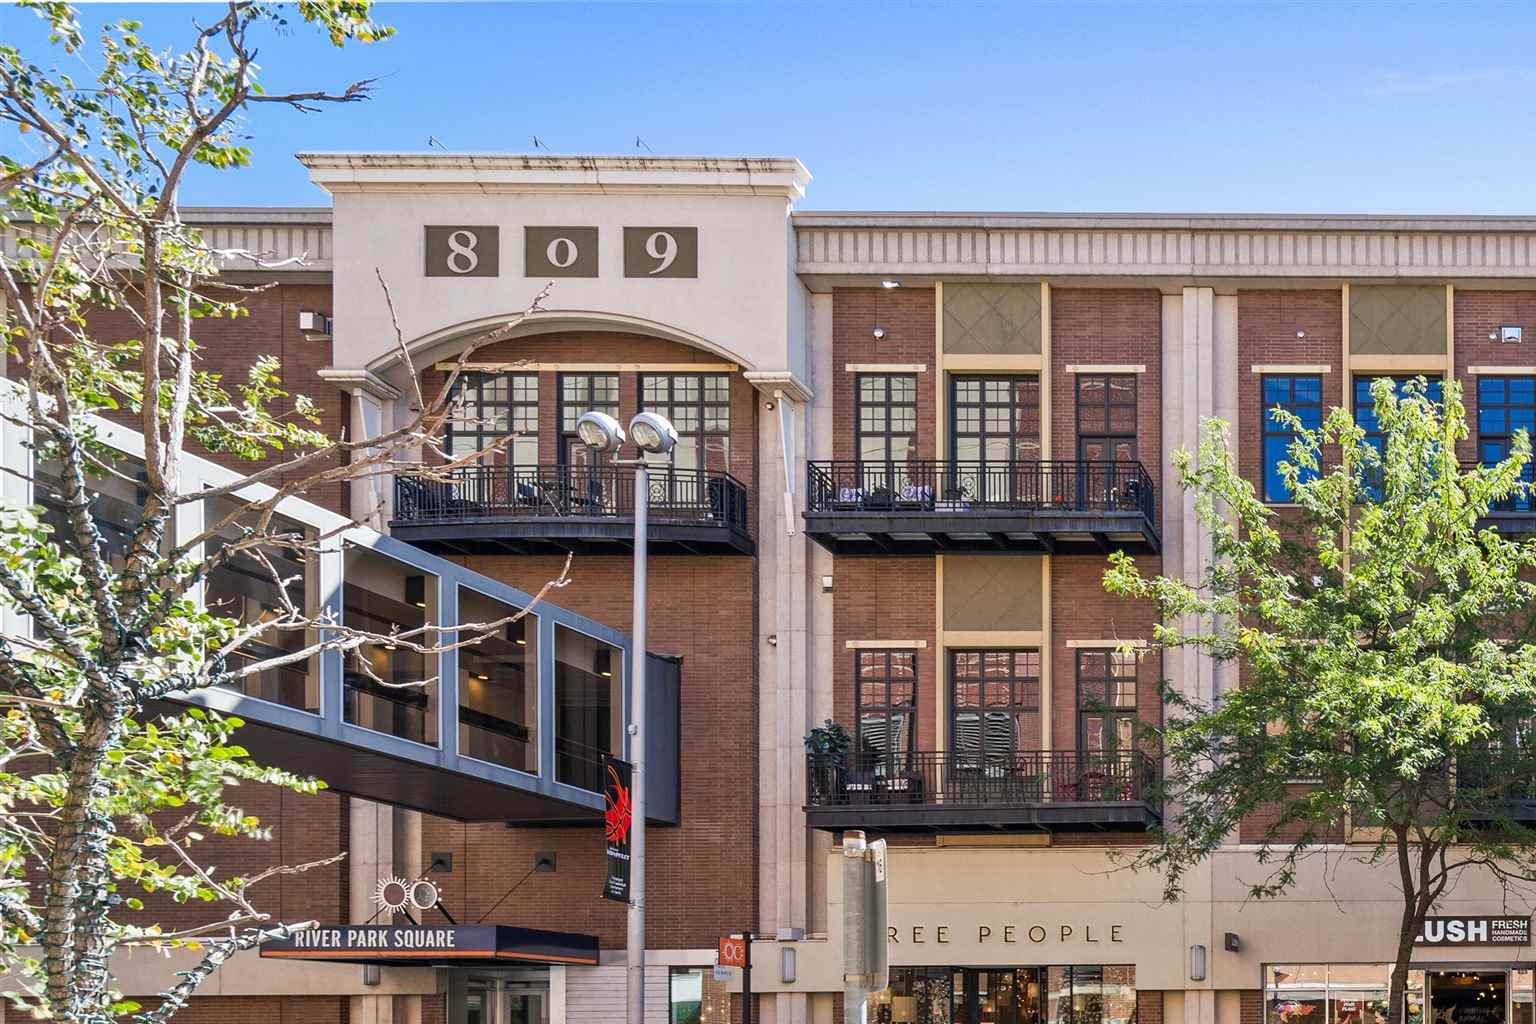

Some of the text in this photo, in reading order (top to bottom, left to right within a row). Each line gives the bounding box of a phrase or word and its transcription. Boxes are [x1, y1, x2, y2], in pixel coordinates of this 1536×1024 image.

[887, 924, 1124, 944] REE PEOPLE
[1414, 920, 1488, 942] USH
[1491, 920, 1528, 929] FRESH
[295, 929, 456, 948] RIVER PARK SQUARE
